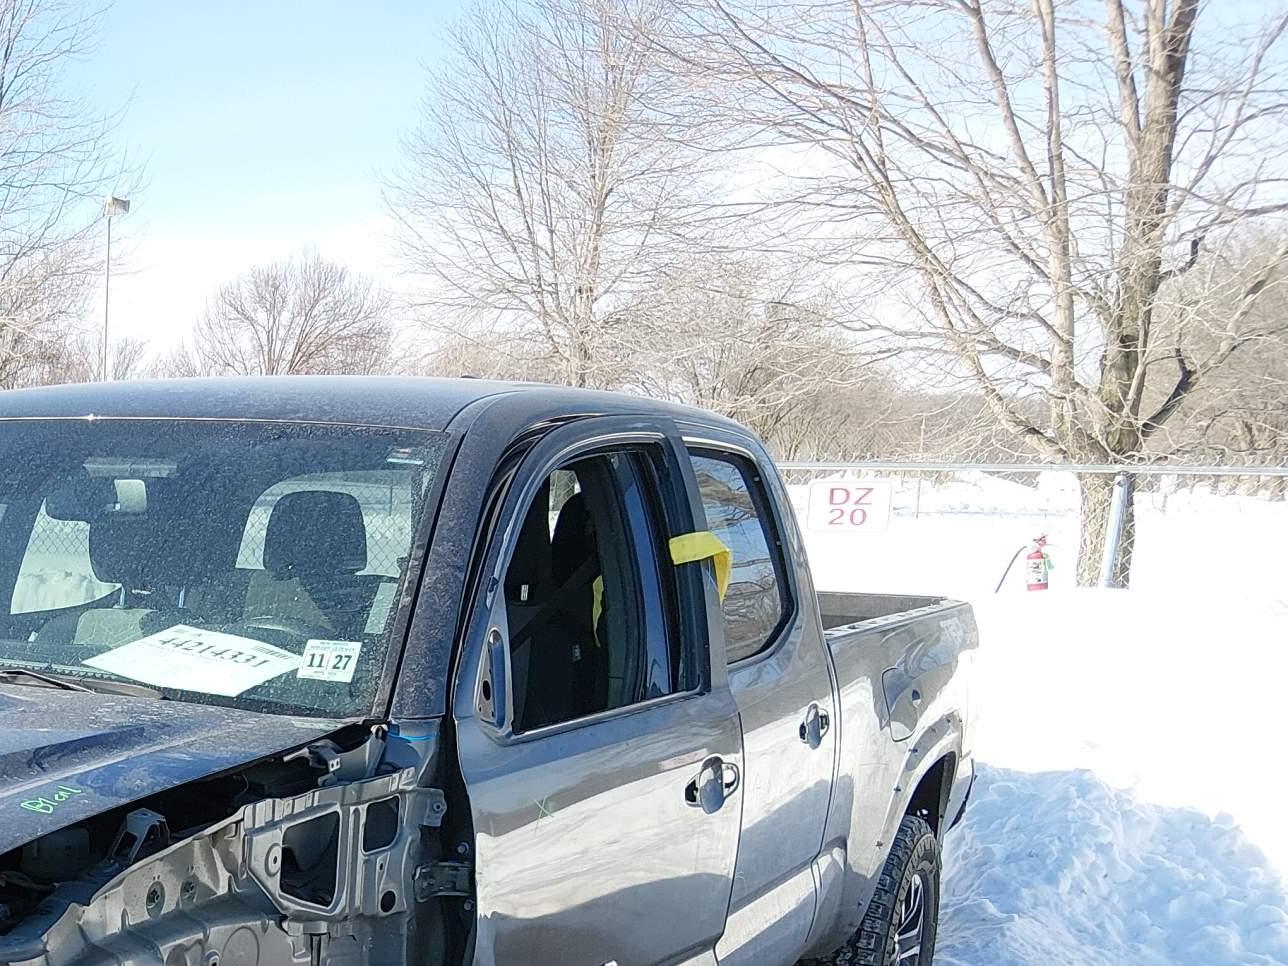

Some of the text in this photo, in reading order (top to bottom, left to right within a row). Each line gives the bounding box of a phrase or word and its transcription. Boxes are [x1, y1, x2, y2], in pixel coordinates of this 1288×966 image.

[829, 487, 874, 506] DZ
[828, 508, 867, 526] 20
[158, 637, 270, 668] 44214331
[307, 652, 353, 671] 11 27
